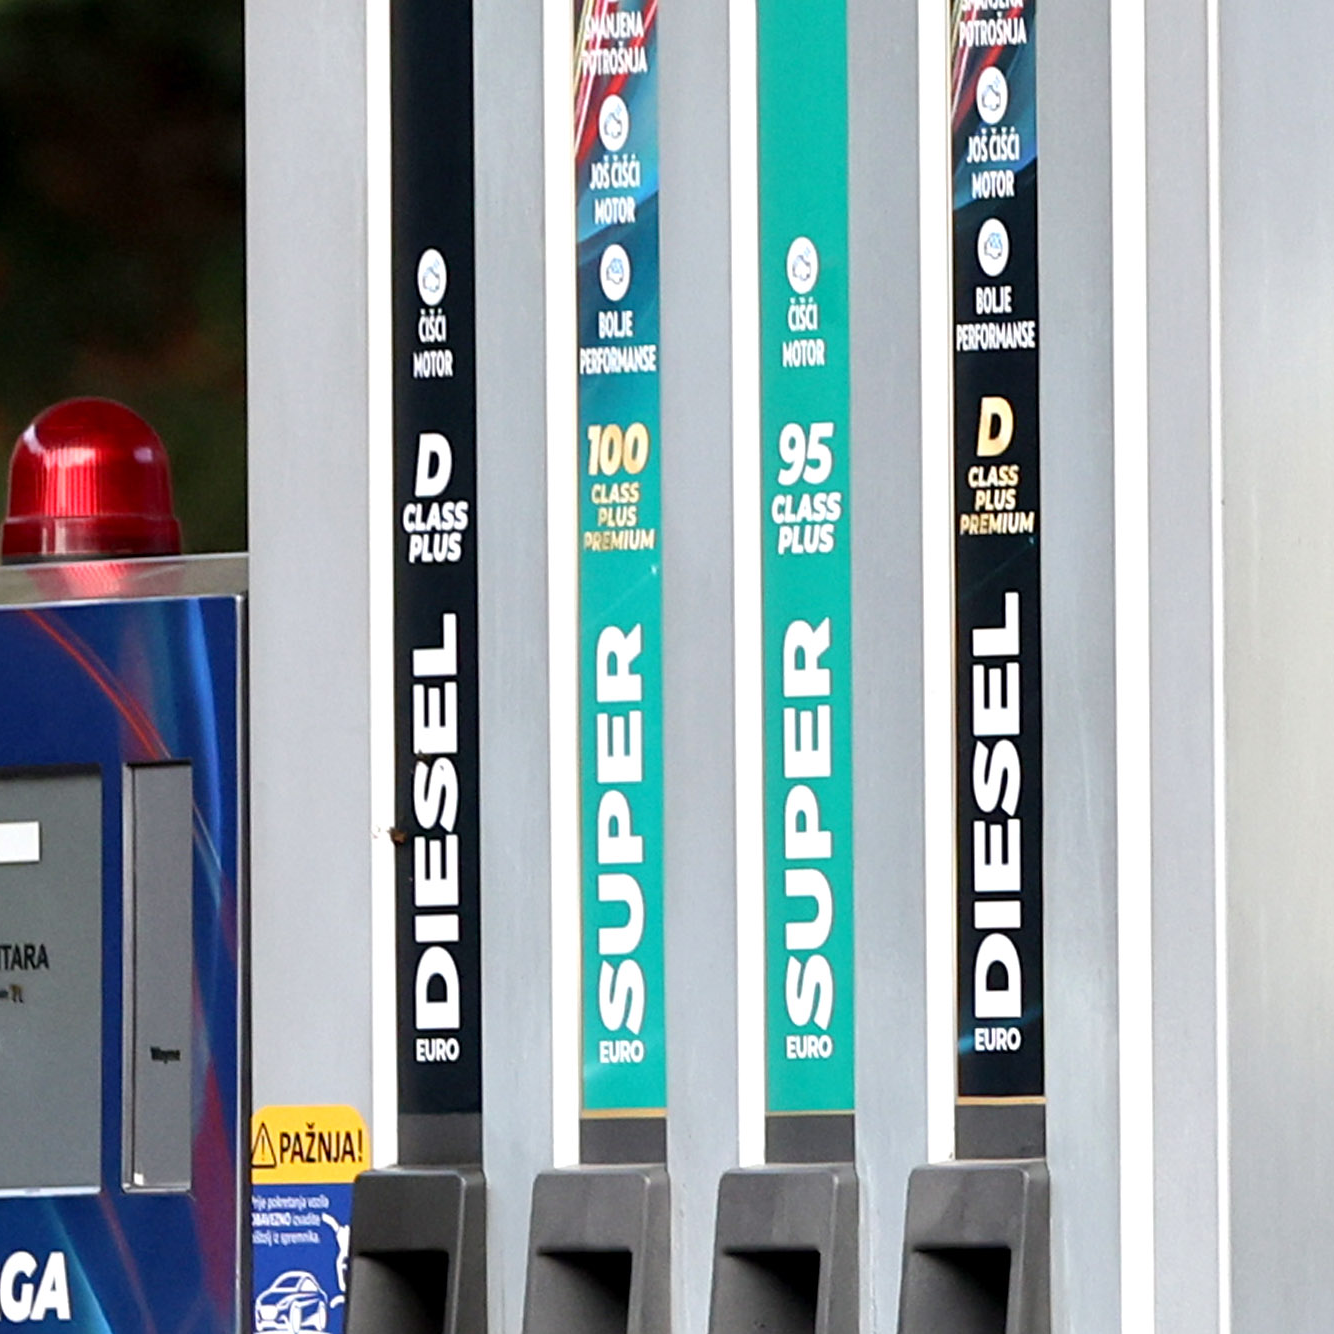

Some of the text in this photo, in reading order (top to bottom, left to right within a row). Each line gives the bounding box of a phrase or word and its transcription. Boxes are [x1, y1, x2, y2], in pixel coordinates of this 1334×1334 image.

[583, 11, 645, 40] SMANJENA
[959, 11, 1028, 47] POTROŠNJA
[581, 41, 648, 75] POTROŠNJA
[966, 126, 1020, 164] JOŠ ČIŠĆI
[589, 154, 641, 190] JOŠ ČIŠĆI
[971, 169, 1015, 199] MOTOR
[594, 196, 636, 225] MOTOR
[787, 296, 818, 332] ČIŠĆI
[975, 286, 1012, 316] BOLJE
[418, 308, 447, 343] ČIŠĆI
[598, 311, 634, 339] BOLJE
[956, 320, 1036, 352] PERFORMANSE
[413, 349, 453, 379] MOTOR
[579, 344, 657, 375] PERFORMANSE
[782, 338, 825, 368] MOTOR
[976, 396, 1014, 457] D
[415, 433, 452, 497] D
[587, 422, 649, 476] 100
[777, 422, 835, 486] 95
[968, 464, 1019, 489] CLASS
[591, 482, 640, 505] CLASS
[771, 491, 842, 525] CLASS
[975, 488, 1017, 511] PLUS
[403, 500, 469, 533] CLASS
[598, 506, 637, 528] PLUS
[960, 512, 1035, 536] PREMIUM
[409, 532, 462, 564] PLUS
[584, 528, 655, 552] PREMIUM
[777, 523, 835, 555] PLUS
[412, 612, 462, 1031] DIESEL
[972, 591, 1022, 1020] DIESEL
[595, 623, 645, 1036] SUPER
[783, 616, 834, 1031] SUPER
[415, 1036, 461, 1062] EURO
[599, 1038, 645, 1064] EURO
[785, 1033, 834, 1060] EURO
[974, 1027, 1021, 1053] EURO
[279, 1122, 363, 1165] PAŽNJA!
